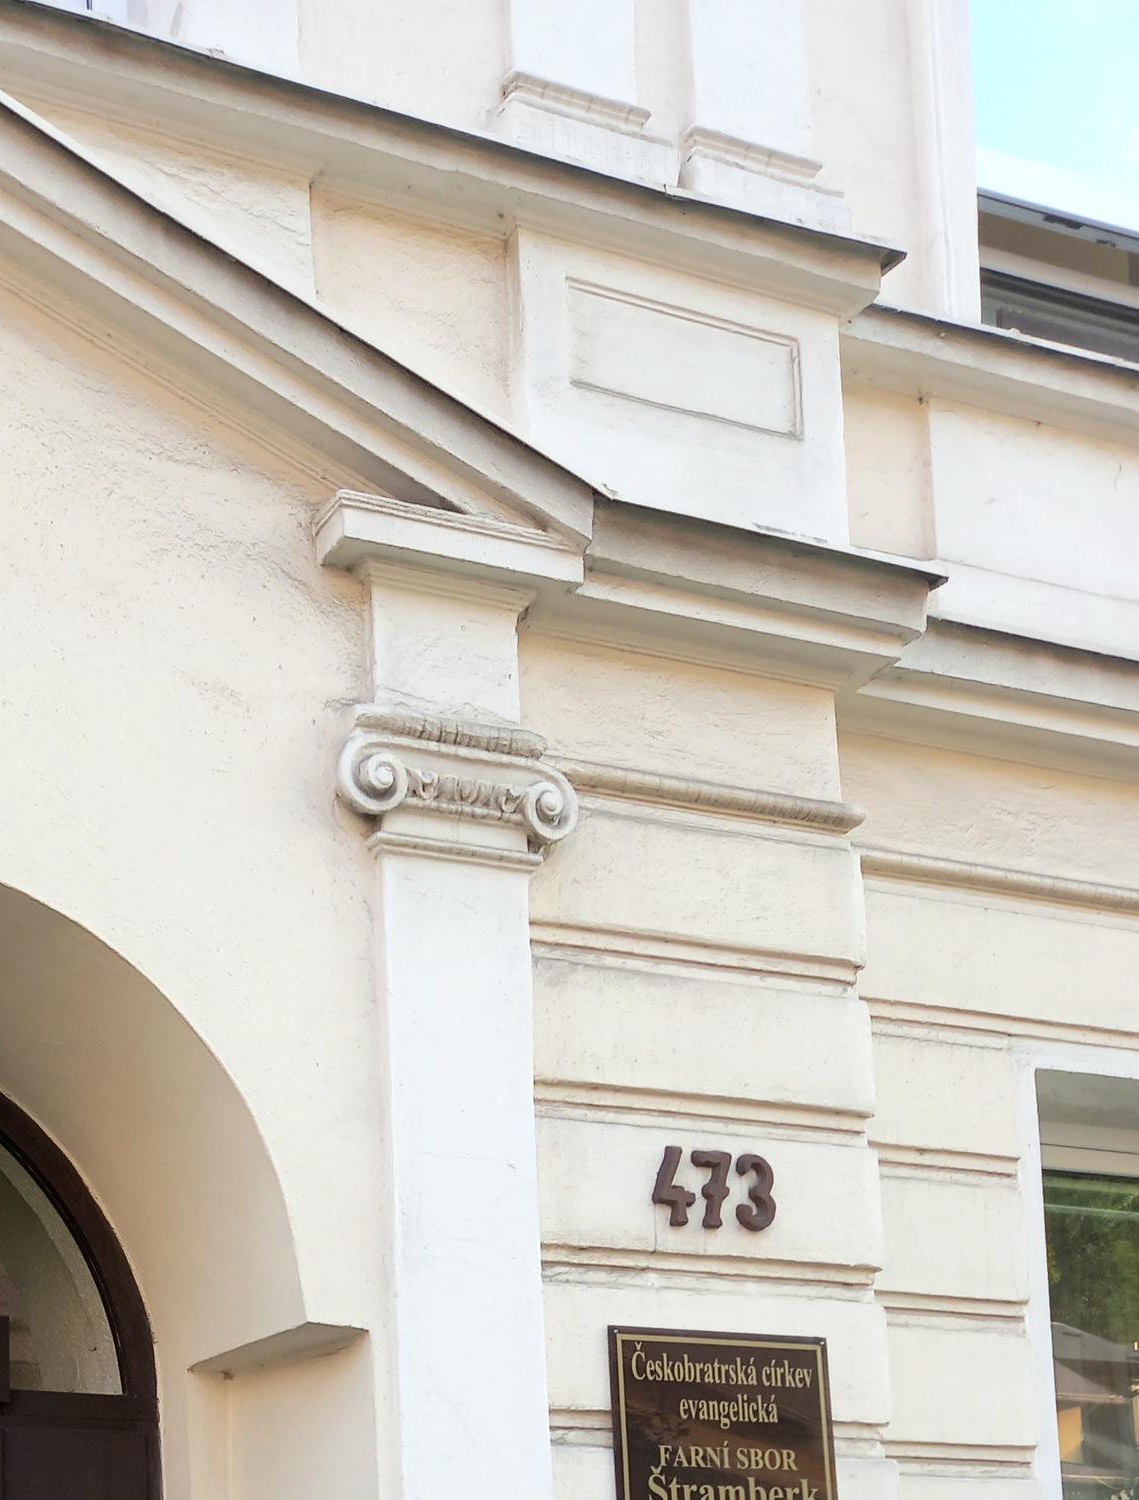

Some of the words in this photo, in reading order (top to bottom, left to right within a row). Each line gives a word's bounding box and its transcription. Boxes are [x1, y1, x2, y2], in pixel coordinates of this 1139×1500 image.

[652, 1146, 777, 1232] 473
[631, 1342, 757, 1386] Českobratrská
[762, 1359, 812, 1388] církev
[679, 1394, 778, 1430] evangelická
[659, 1441, 730, 1469] FARNÍ
[736, 1447, 798, 1471] SBOR
